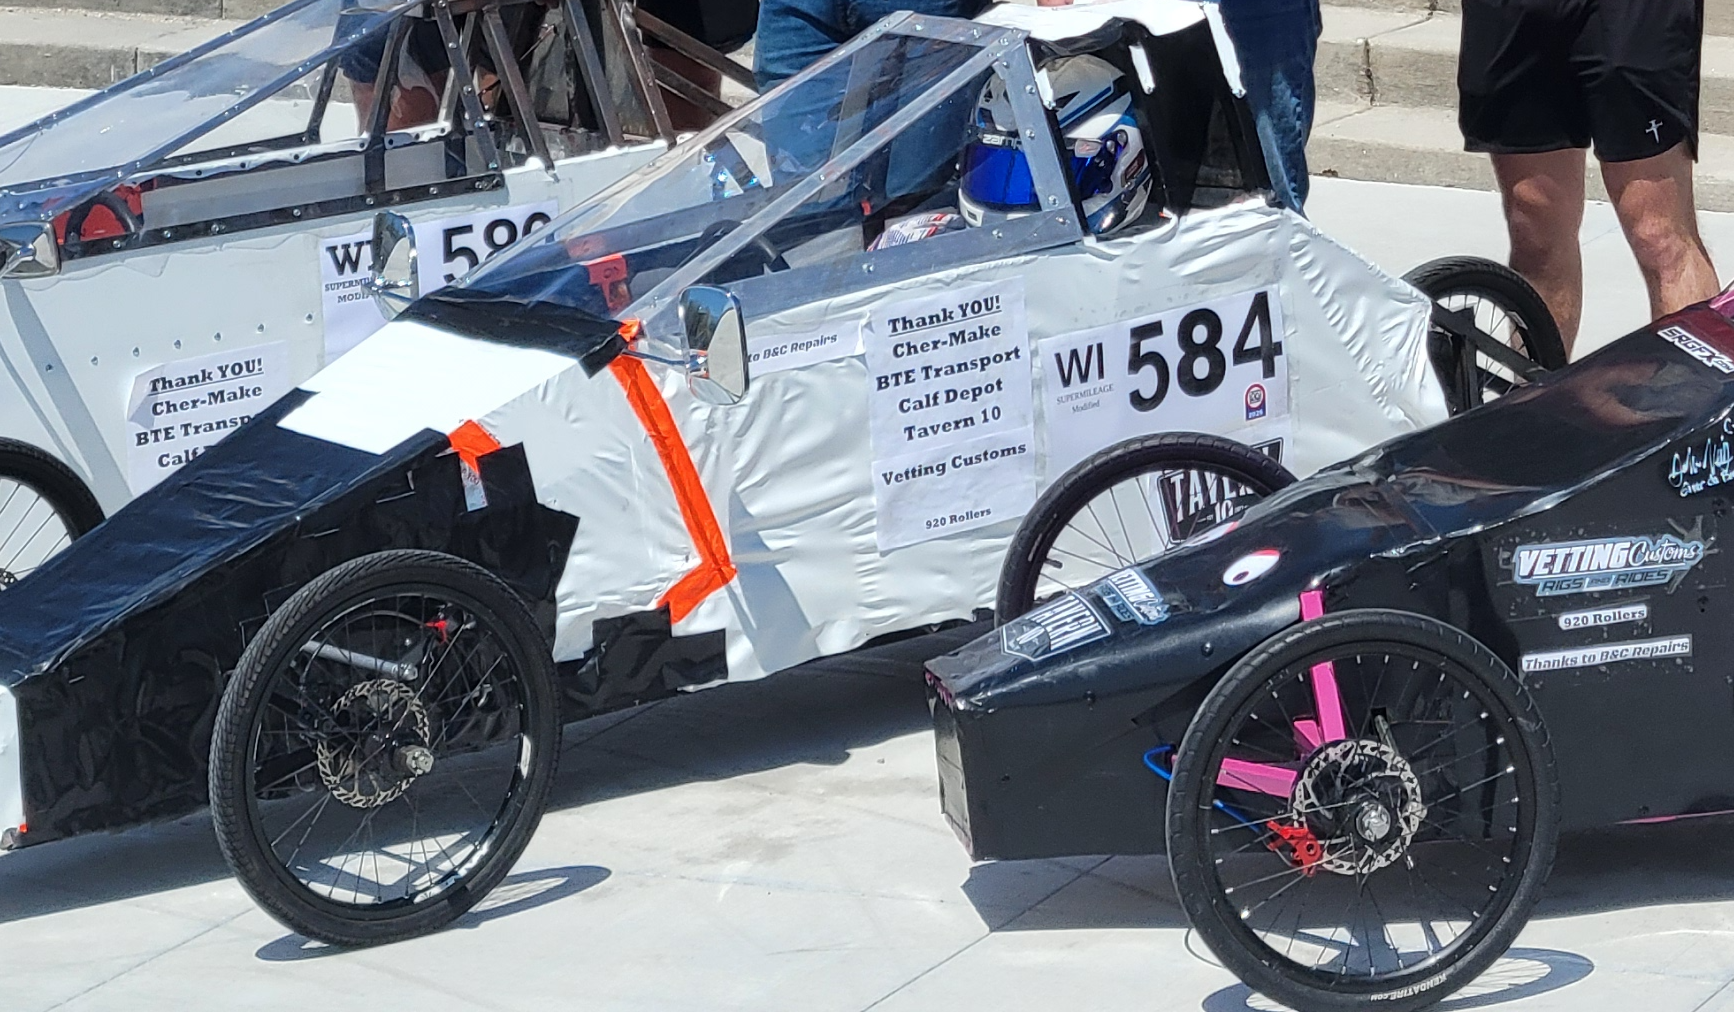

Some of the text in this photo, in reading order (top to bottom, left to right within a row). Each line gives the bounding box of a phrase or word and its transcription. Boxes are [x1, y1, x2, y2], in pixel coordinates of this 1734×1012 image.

[888, 295, 1002, 334] Thank YOU!
[790, 332, 838, 355] Repairs
[892, 324, 1002, 359] Cher-Make
[1054, 291, 1283, 412] WI 584
[149, 358, 263, 393] Thank YOU!
[875, 346, 1021, 391] BTE Transport
[151, 385, 263, 416] Cher-Make
[898, 378, 1004, 413] Calf Depot
[1056, 384, 1114, 404] SUPERMILEAGE
[1072, 399, 1100, 414] Modified
[135, 415, 251, 447] BTE Transp
[904, 405, 1002, 441] Tavern 10
[881, 442, 1027, 487] Vetting Customs
[925, 505, 992, 530] 920 Rollers
[1518, 539, 1697, 578] VETTING Customs
[1540, 577, 1585, 593] RIGS
[1614, 569, 1670, 586] RIDES
[1563, 608, 1646, 629] 920 Rollers
[1524, 638, 1690, 671] Thanks to B&C Repairs
